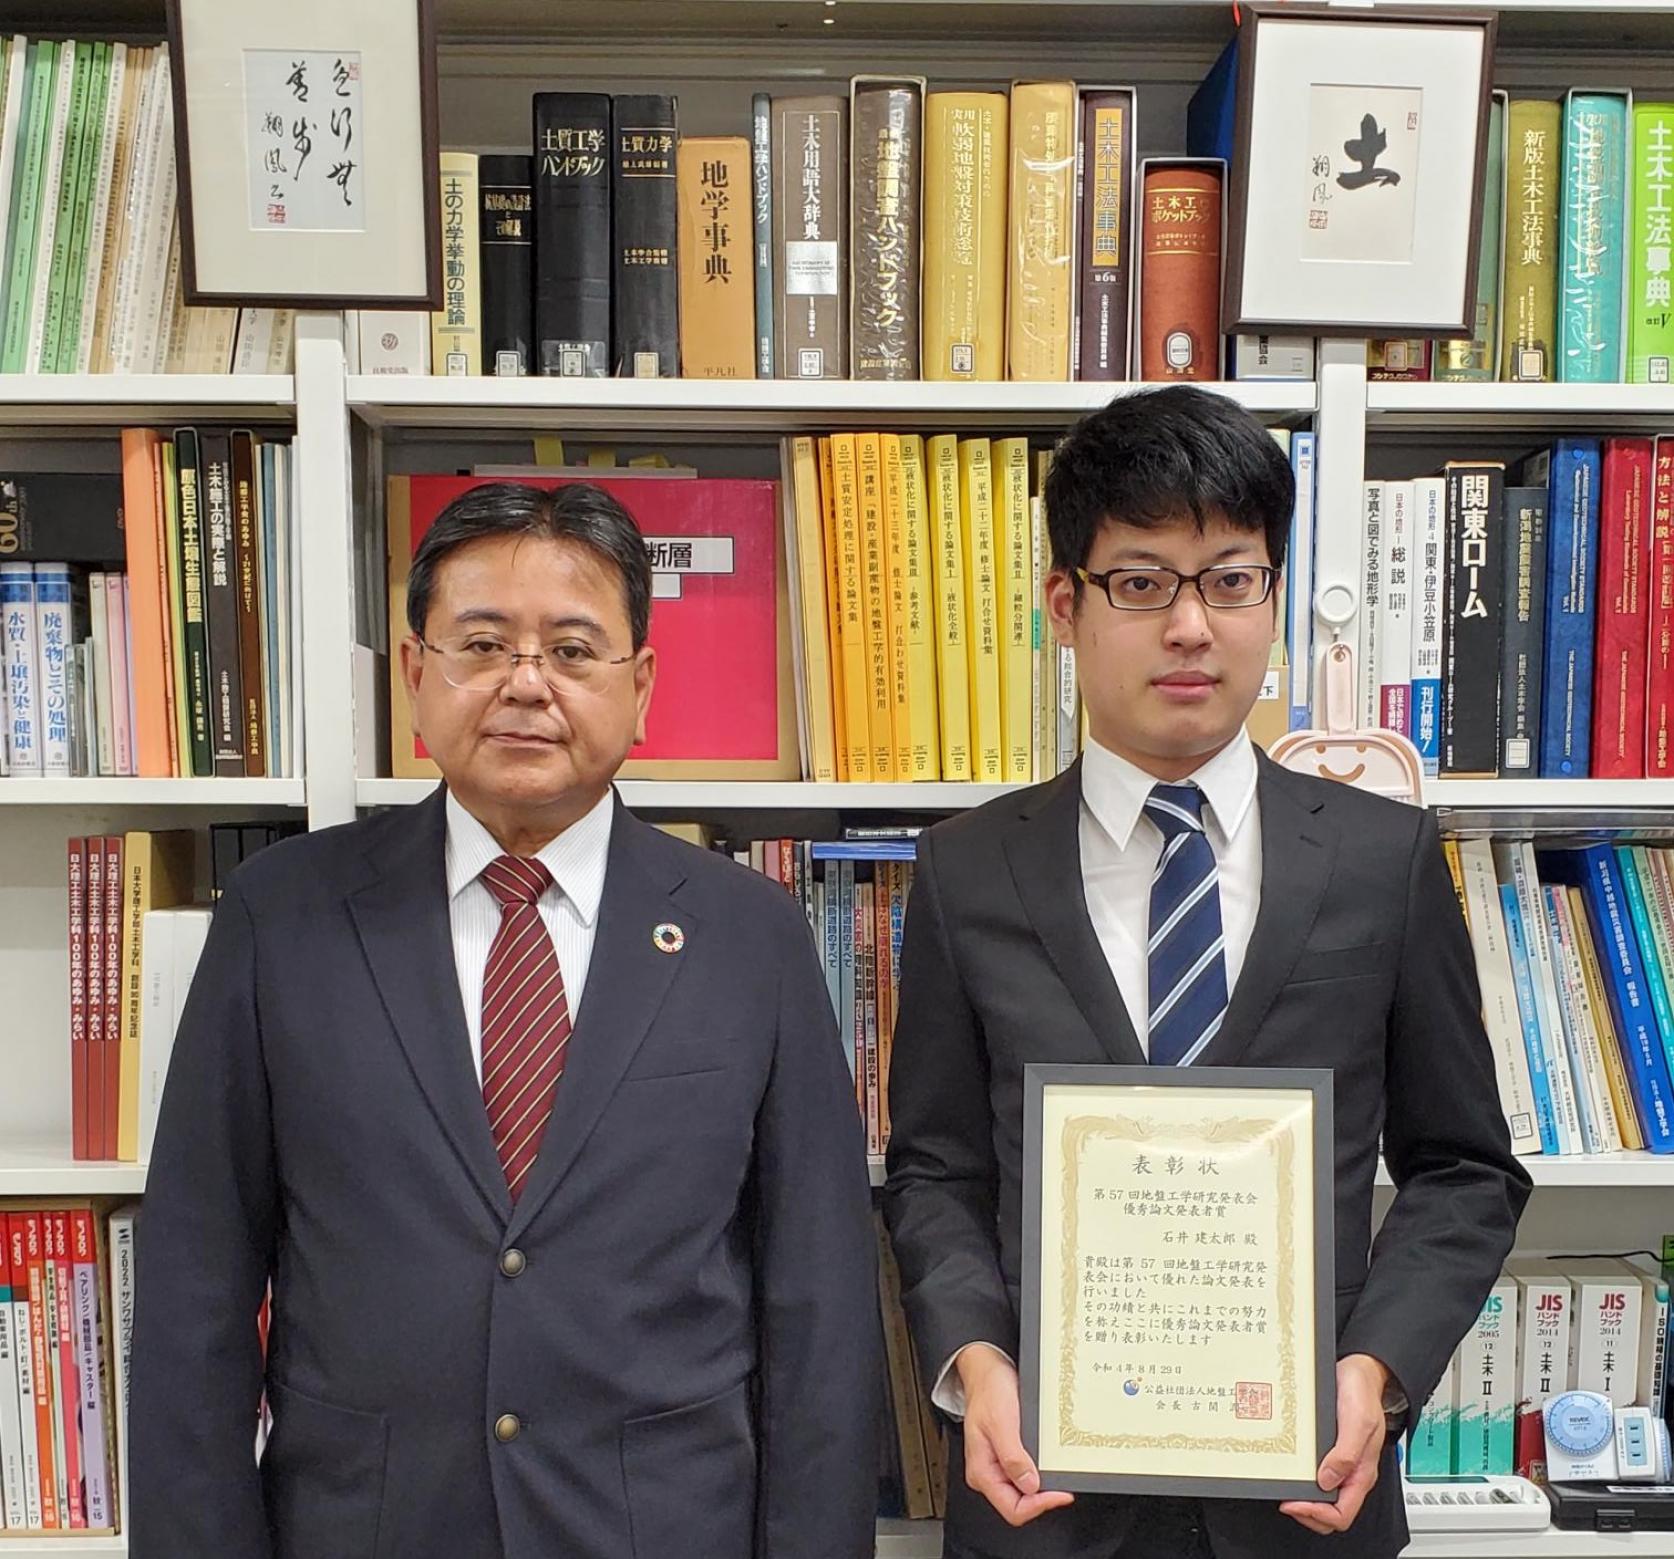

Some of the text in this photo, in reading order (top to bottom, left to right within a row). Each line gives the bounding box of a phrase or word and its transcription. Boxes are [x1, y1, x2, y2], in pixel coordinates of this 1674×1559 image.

[541, 129, 606, 151] 土質工学
[1336, 113, 1400, 191] 土
[541, 156, 604, 178] ハンドブック
[802, 114, 821, 240] 土木用語大辞典
[1096, 117, 1119, 255] 土木工法事典
[1520, 129, 1546, 266] 新版土木工法事典
[700, 160, 732, 284] 地学事典
[1645, 120, 1673, 308] 土木工法事典
[444, 178, 465, 325] 土の力学挙動の理論
[1655, 456, 1671, 539] 方法と解説
[208, 461, 228, 587] 土木施工の実際と解説
[1366, 488, 1380, 608] 写真と図でみる地形学
[1461, 475, 1490, 619] 関東ローム
[1423, 542, 1438, 642] 関東・伊豆小笠原
[8, 611, 32, 750] 水質・土壌汚染と健康
[43, 612, 66, 743] 廃棄物とその処理
[1132, 1154, 1220, 1176] 表彰状
[1123, 1202, 1227, 1218] 優秀論文発表者賞
[1162, 1230, 1189, 1244] 石井
[1083, 1271, 1266, 1289] 表会において優れた論文発表を
[1083, 1286, 1147, 1299] 行いました
[1536, 1294, 1563, 1311] JIS
[1599, 1293, 1626, 1311] JIS
[1083, 1300, 1267, 1319] その功績と共にこれまでの努力
[1083, 1315, 1268, 1334] を称えここに優秀論文発表者賞
[1478, 1321, 1500, 1329] ブック
[1537, 1319, 1559, 1327] ブック
[1600, 1318, 1622, 1326] ブック
[1083, 1329, 1213, 1346] を贈り表彰いたします
[1482, 1355, 1494, 1376] 土木
[1540, 1352, 1552, 1374] 土木
[1603, 1351, 1615, 1373] 土木
